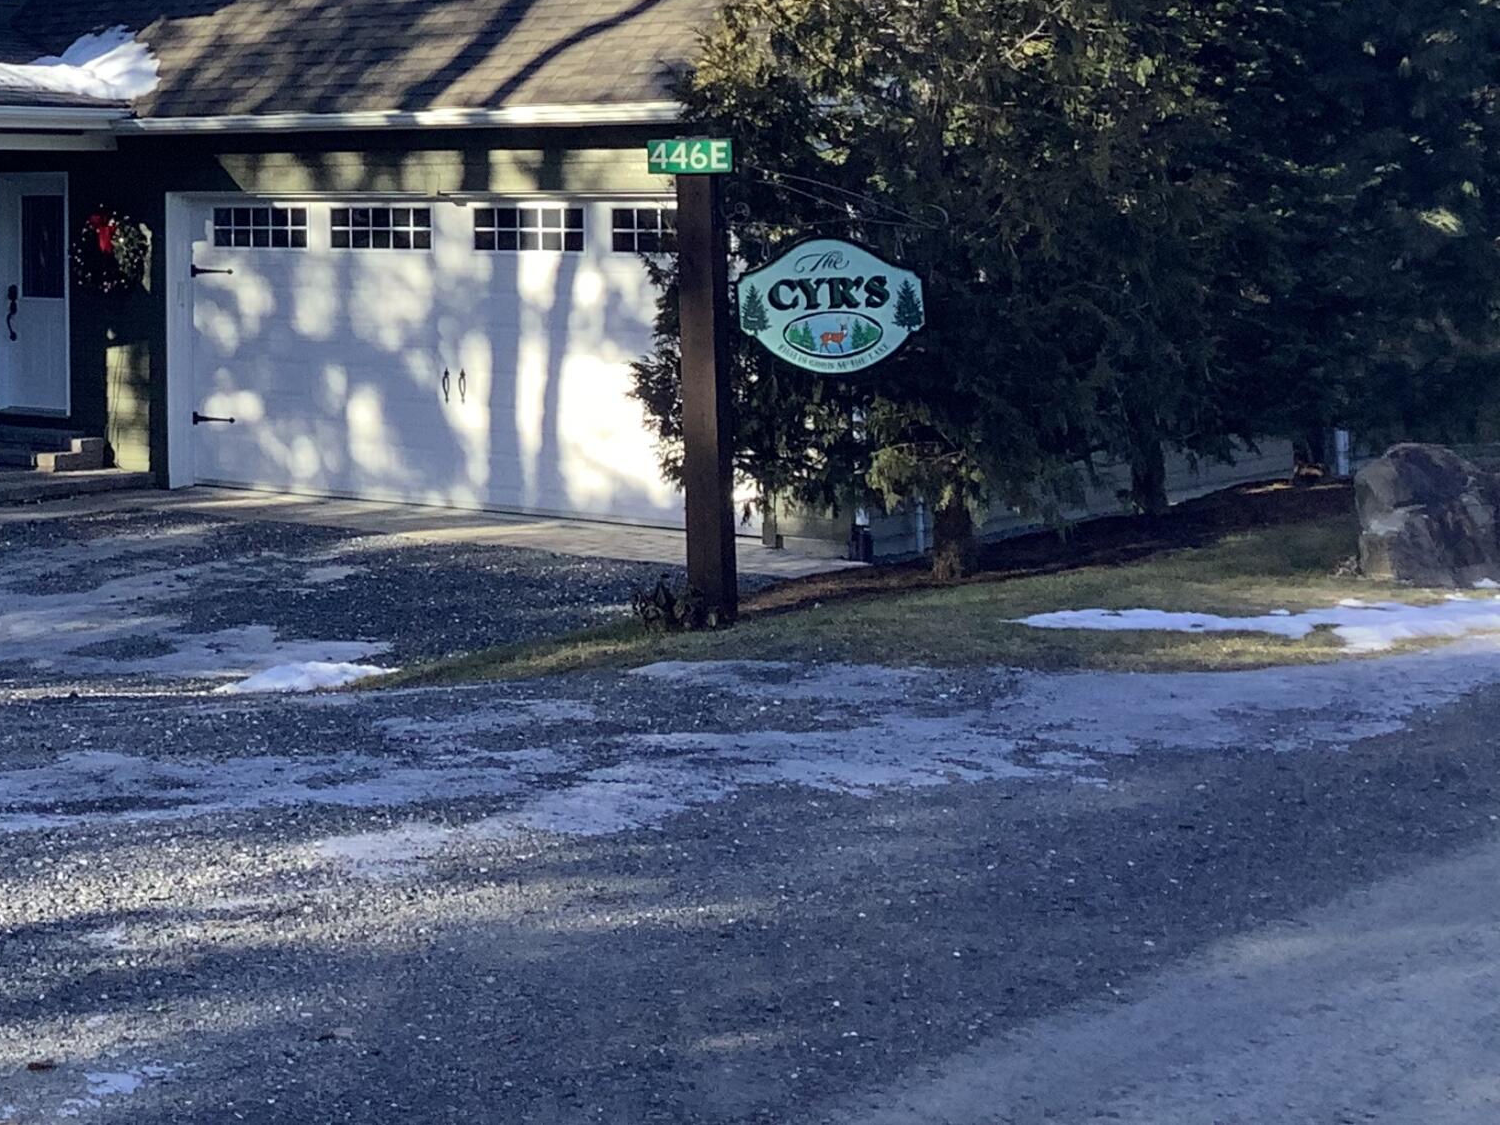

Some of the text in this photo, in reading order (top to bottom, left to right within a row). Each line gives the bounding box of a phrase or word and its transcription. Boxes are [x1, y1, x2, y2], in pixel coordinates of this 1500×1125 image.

[649, 142, 728, 169] 446E
[795, 250, 849, 273] The
[768, 275, 890, 311] CYR'S
